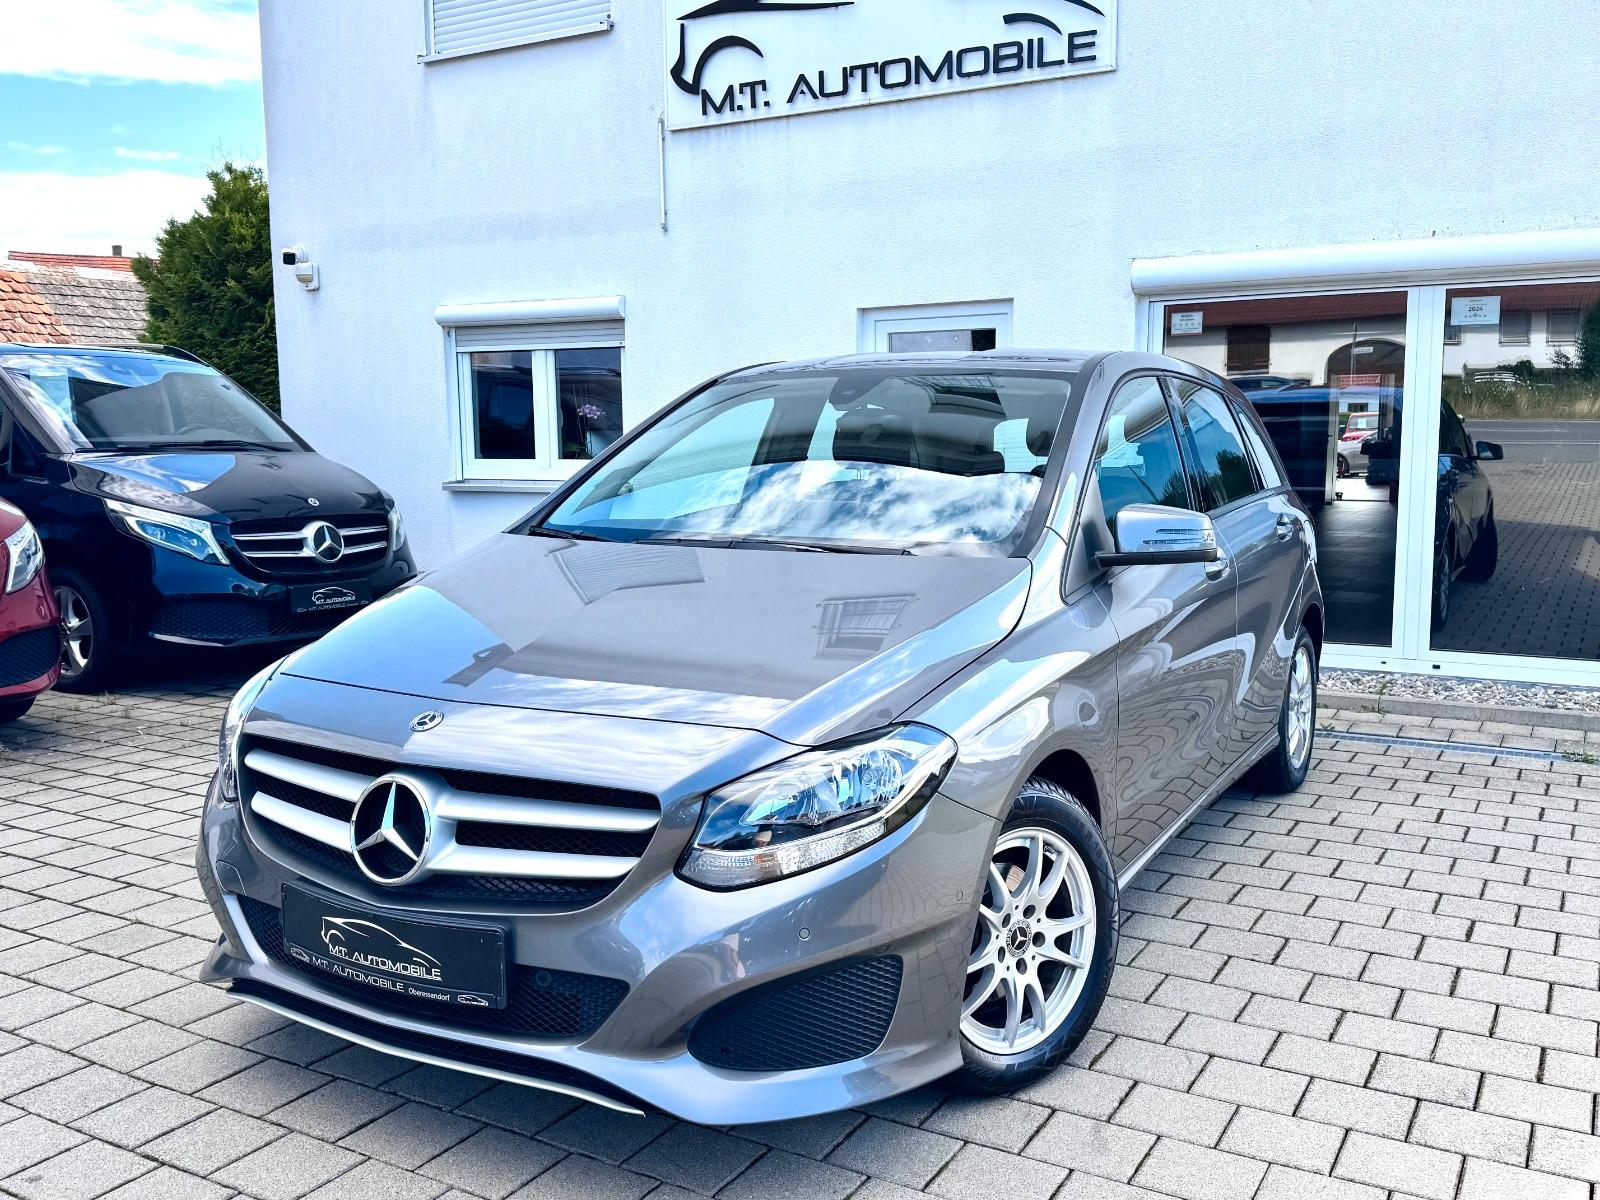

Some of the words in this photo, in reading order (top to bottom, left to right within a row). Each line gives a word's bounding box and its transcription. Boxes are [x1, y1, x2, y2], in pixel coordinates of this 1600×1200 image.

[701, 79, 770, 116] M.T.
[786, 29, 1098, 104] AUTOMOBILE
[312, 955, 330, 970] M.T.
[332, 964, 405, 993] AUTOMOBILE
[328, 943, 349, 959] M.T.
[352, 951, 441, 980] AUTOMOBILE
[408, 987, 451, 1002] Oberessendorf
